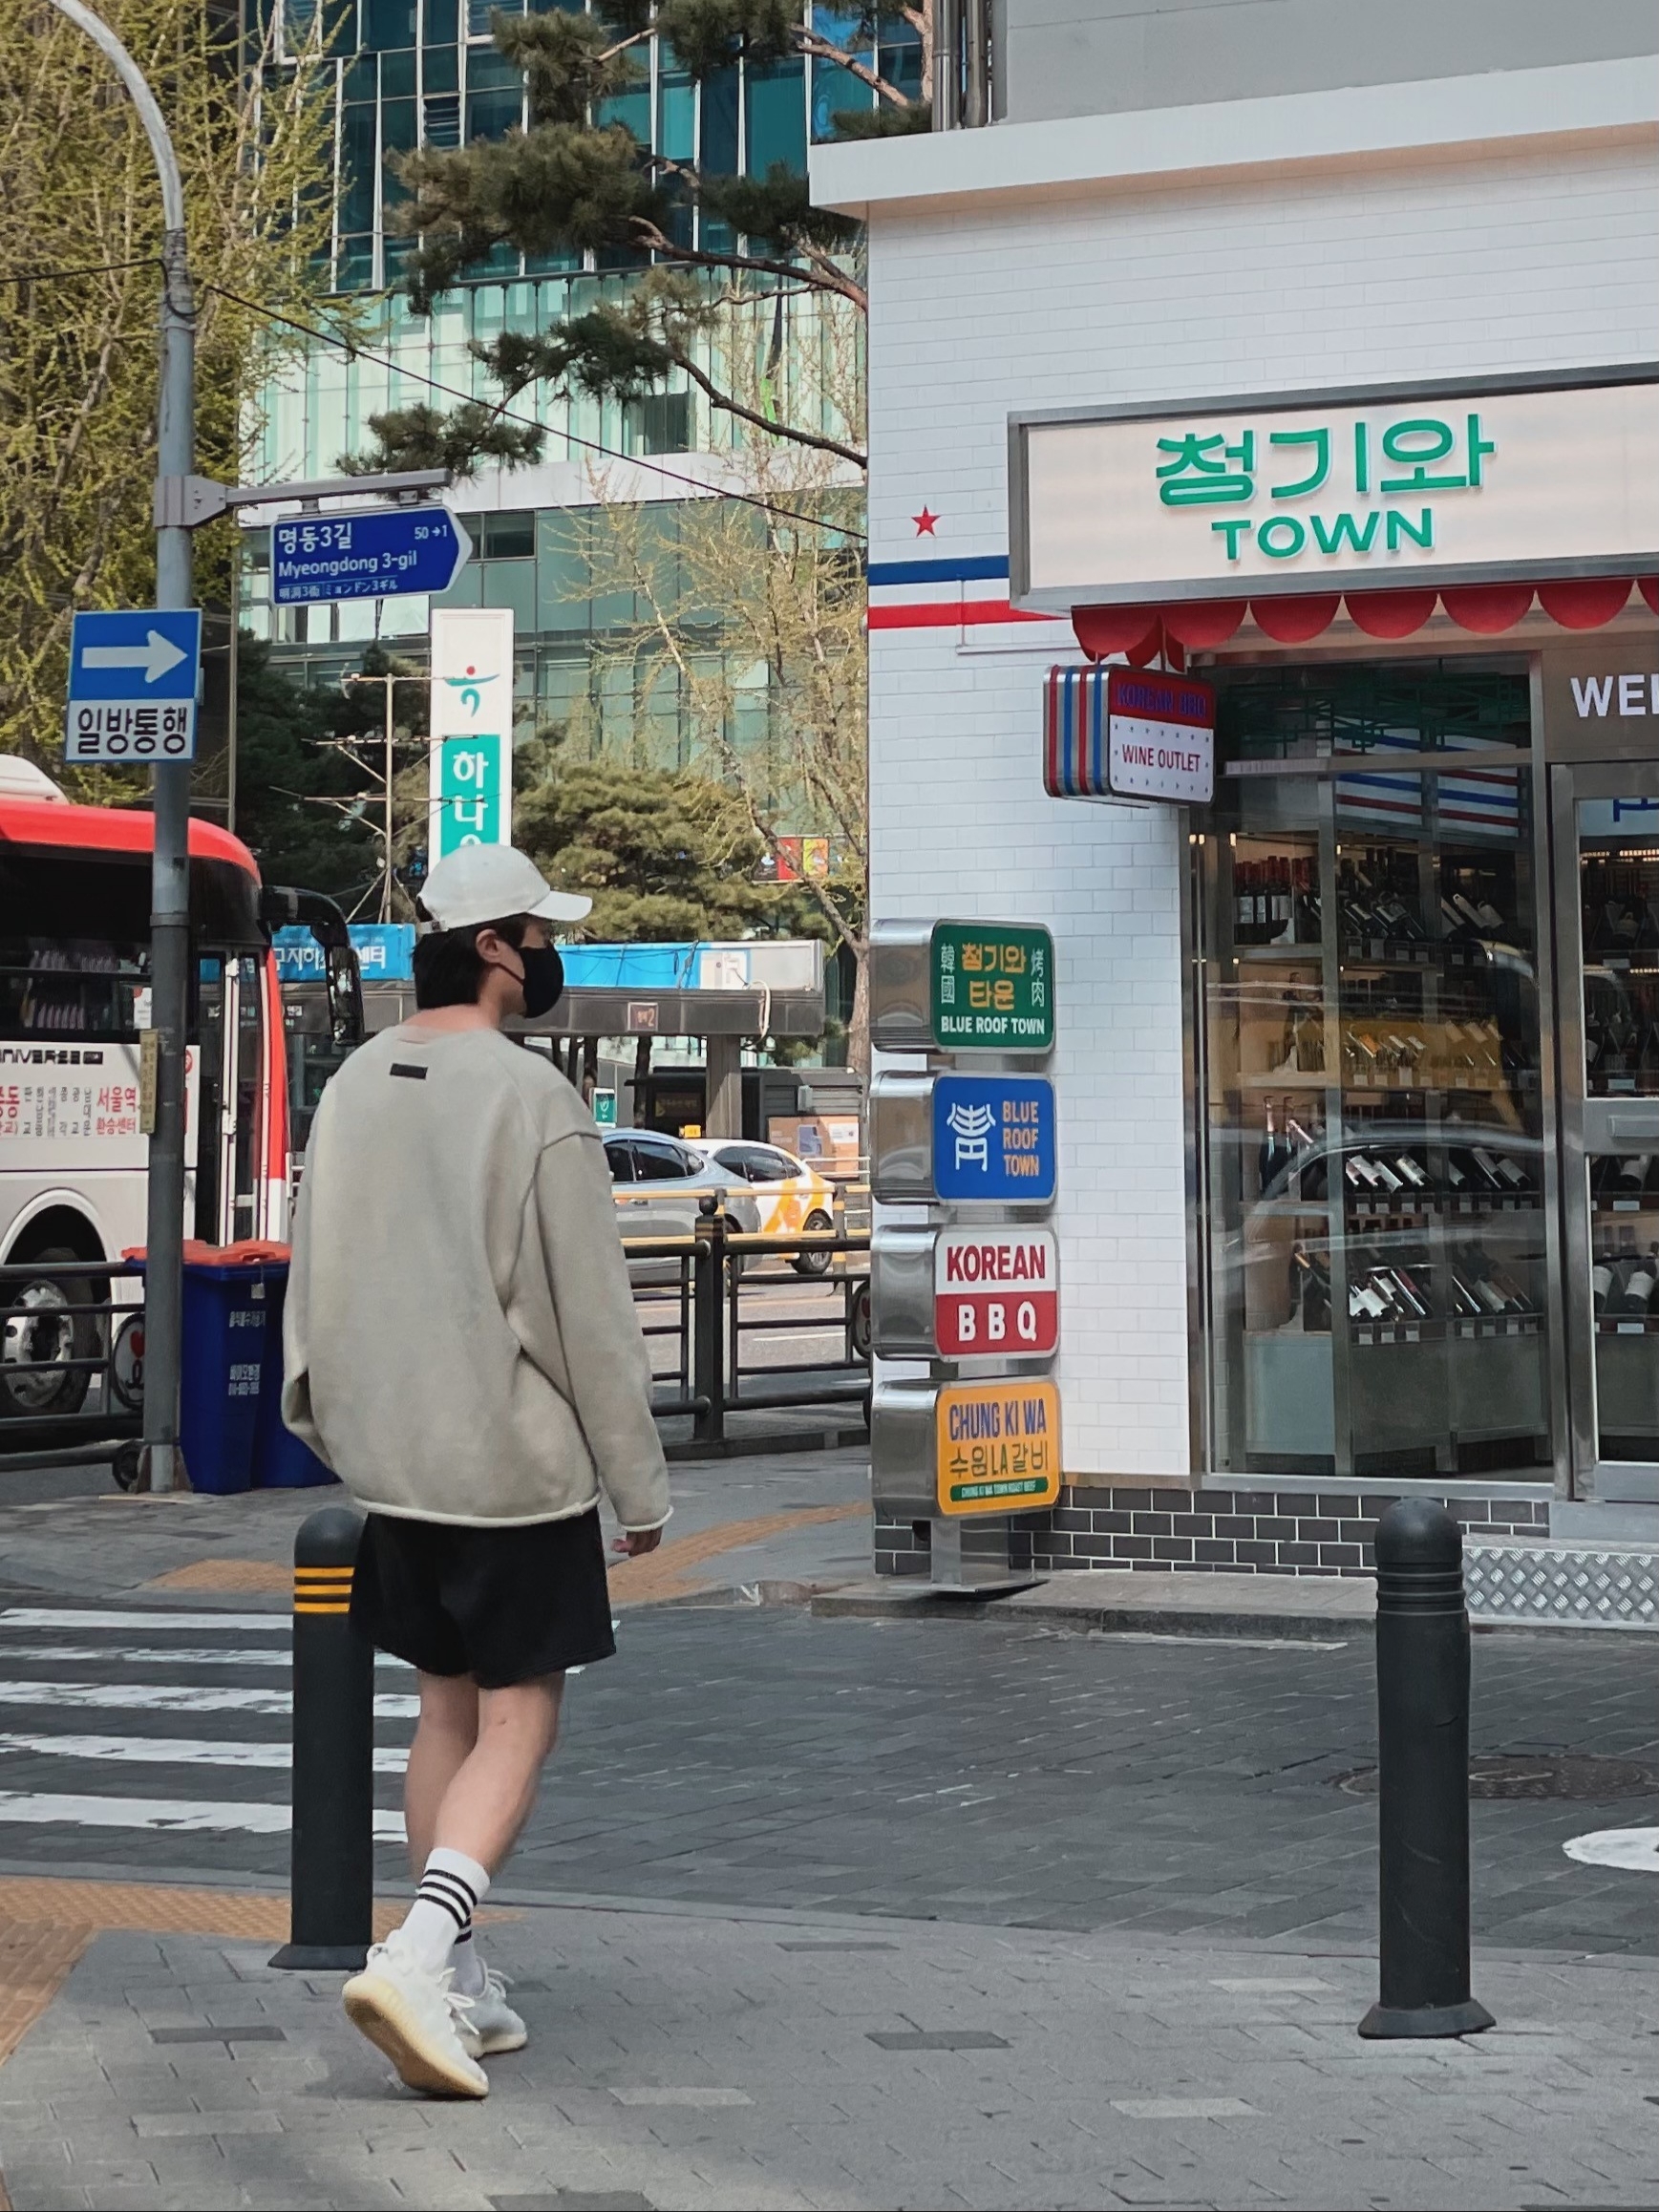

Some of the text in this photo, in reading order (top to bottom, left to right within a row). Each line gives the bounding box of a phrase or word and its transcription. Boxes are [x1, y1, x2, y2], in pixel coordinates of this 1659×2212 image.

[1156, 414, 1495, 506] 청기와
[279, 521, 352, 555] 명동3길
[415, 526, 429, 541] 50
[1211, 508, 1433, 561] TOWN
[278, 549, 418, 579] Myeongdong 3-gil
[77, 706, 187, 755] 일방통행
[1122, 744, 1201, 772] WINE OUTLET
[962, 942, 1027, 974] 청기와
[1031, 948, 1045, 1008] 烤肉
[969, 979, 1015, 1010] 타운
[941, 1015, 1045, 1035] BLUE ROOF TOWN
[96, 1086, 136, 1113] 서울역
[1002, 1100, 1039, 1124] BLUE
[96, 1117, 136, 1136] 환승센터
[1003, 1127, 1039, 1150] ROOF
[1004, 1154, 1040, 1178] TOWN
[946, 1244, 1046, 1282] KOREAN
[949, 1397, 1047, 1441] CHUNG KI WA
